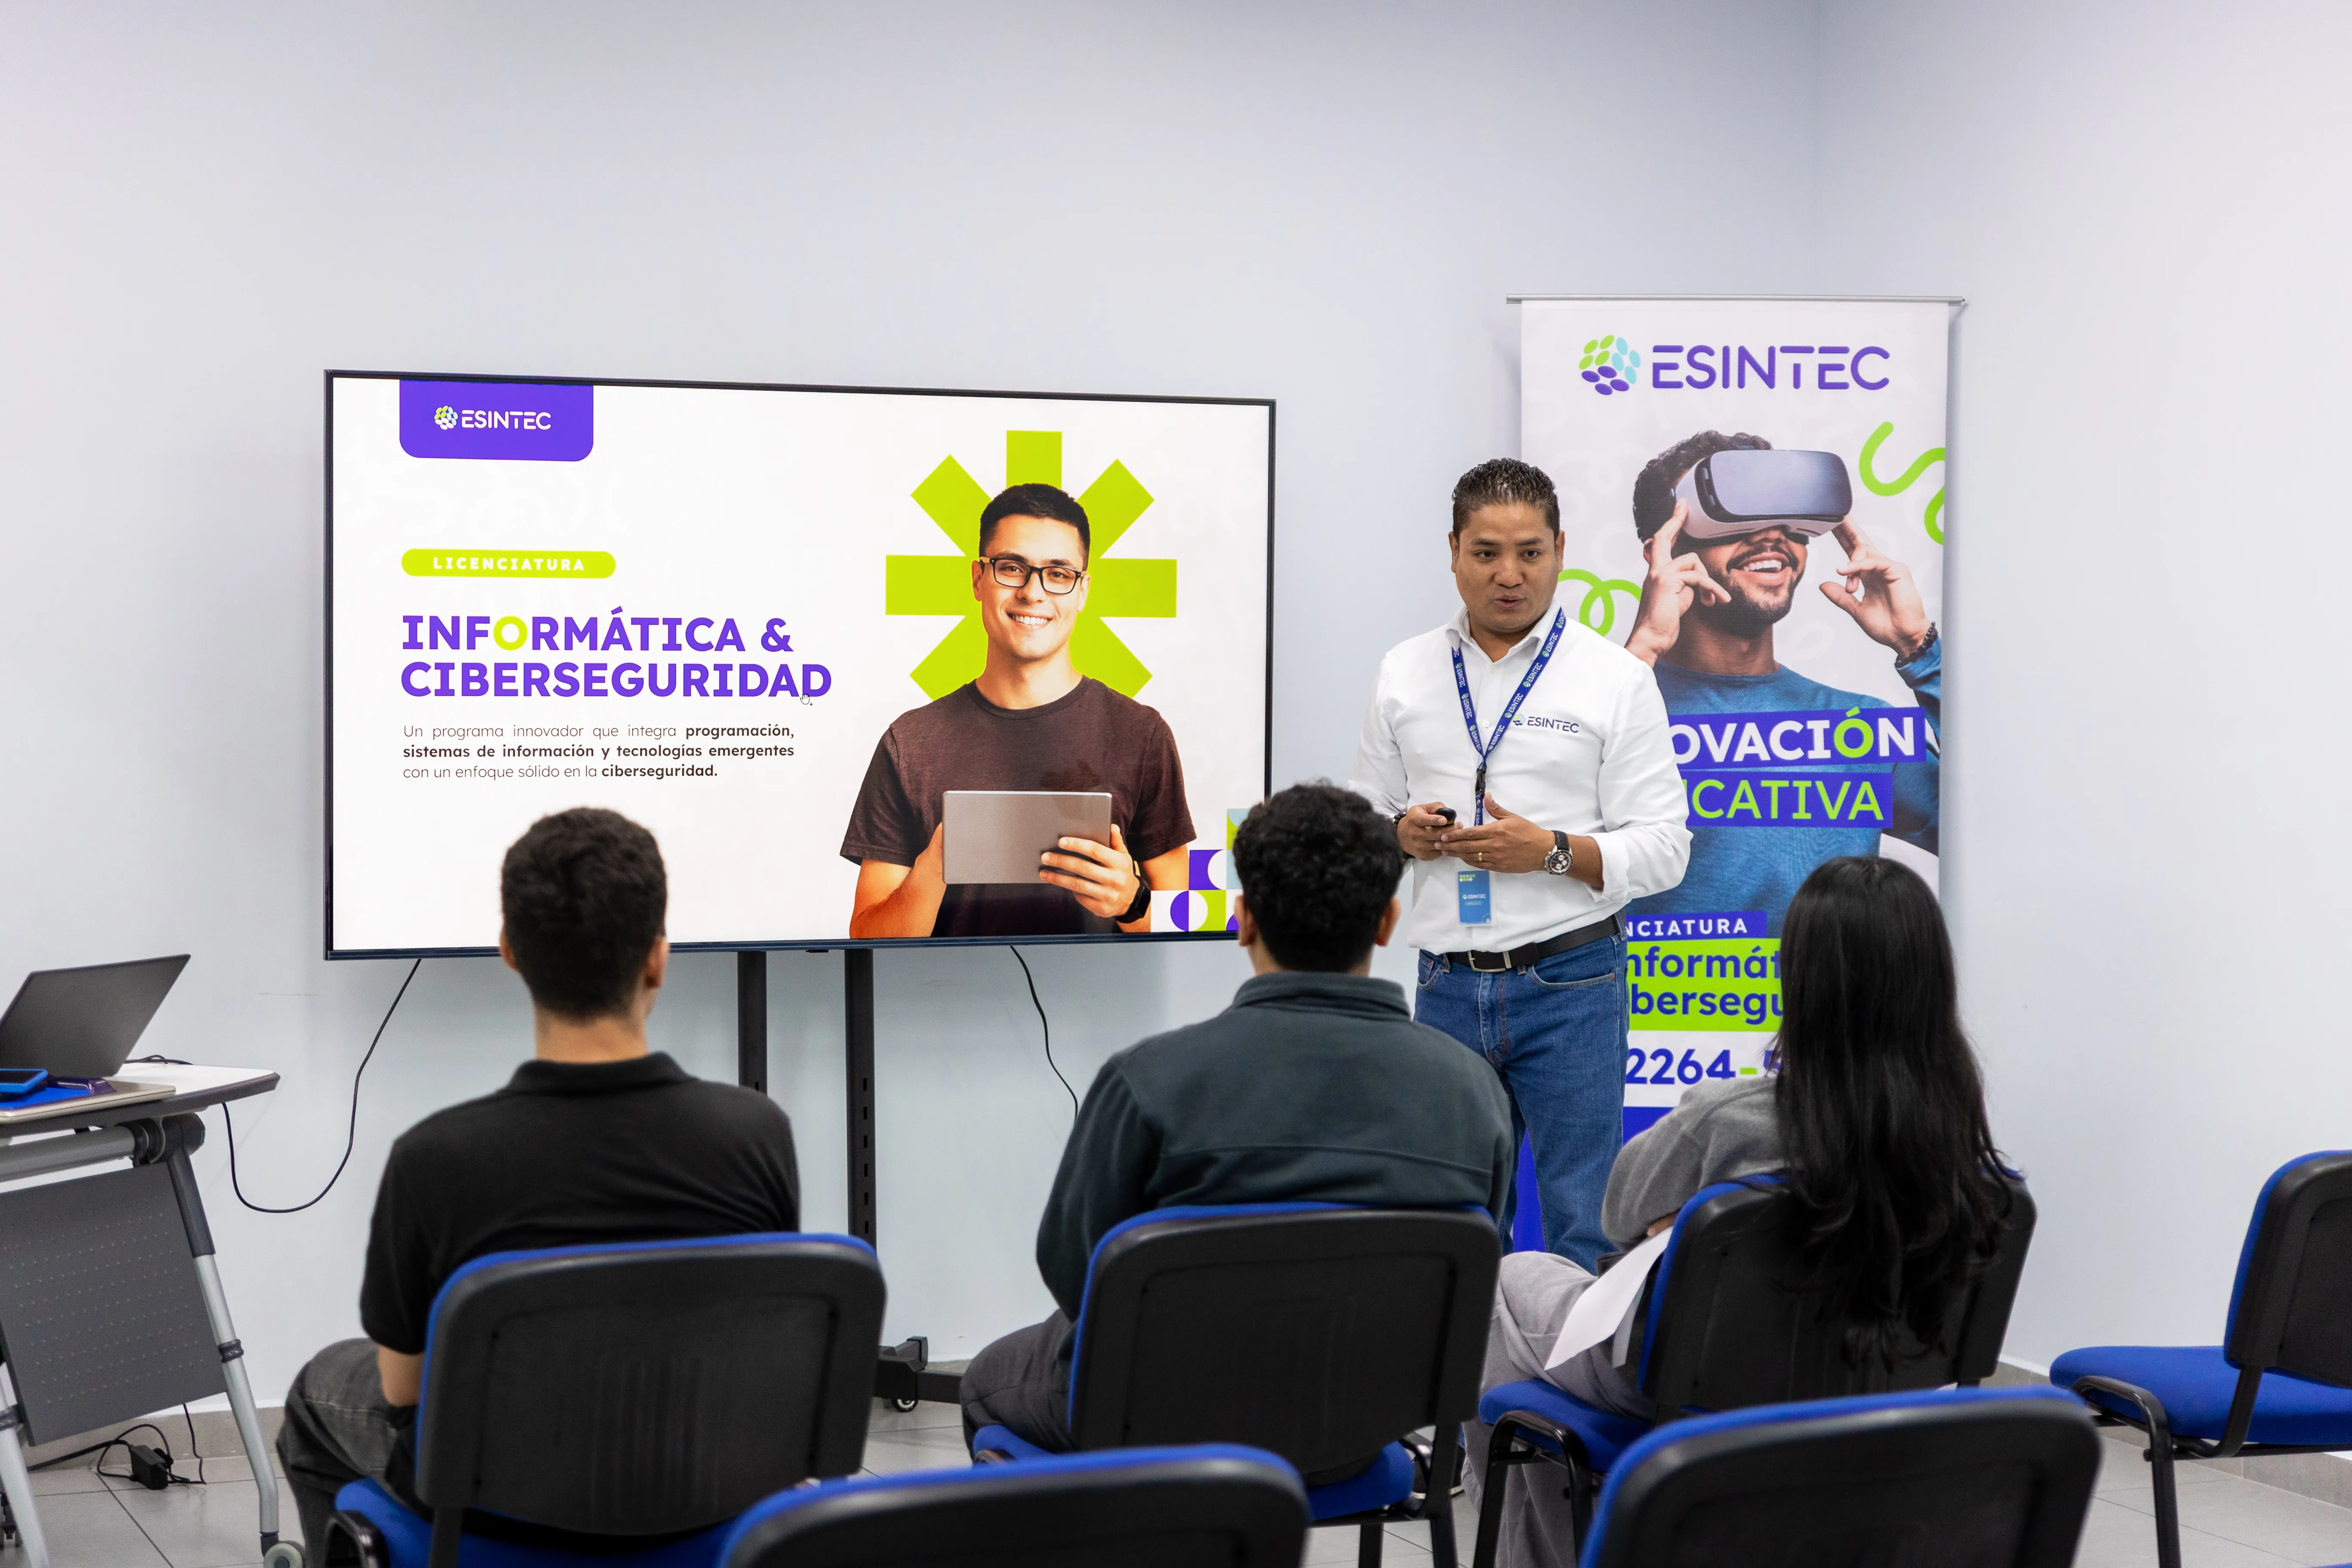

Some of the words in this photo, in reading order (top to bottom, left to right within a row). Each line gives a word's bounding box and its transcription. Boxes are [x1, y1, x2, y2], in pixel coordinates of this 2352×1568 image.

[1652, 345, 1890, 391] ESINTEC
[462, 410, 551, 430] ESINTEC
[434, 557, 584, 571] LICENCIATURA
[403, 606, 746, 652] INFORMÁTICA
[761, 618, 794, 652] &
[1546, 633, 1558, 652] ESINTEC
[401, 662, 832, 698] CIBERSEGURIDAD
[1457, 668, 1465, 687] ESINTEC
[1527, 662, 1542, 683] ESINTEC
[1463, 698, 1472, 719] ESINTEC
[1508, 693, 1523, 713] ESINTEC
[404, 725, 423, 737] Un
[433, 728, 503, 741] programa
[514, 725, 584, 737] innovador
[593, 728, 619, 740] que
[628, 724, 676, 740] integra
[686, 723, 794, 740] programación,
[1491, 725, 1504, 745] ESINTEC
[1527, 717, 1579, 733] ESINTEC
[1471, 730, 1482, 751] ESINTEC
[1669, 707, 1915, 764] OVACIÓN
[403, 744, 470, 757] sistemas
[477, 745, 495, 757] de
[503, 744, 594, 757] información
[601, 748, 610, 760] y
[616, 744, 702, 760] tecnologías
[709, 745, 794, 760] emergentes
[403, 769, 429, 778] con
[434, 769, 450, 778] un
[456, 766, 514, 781] enfoque
[518, 765, 560, 778] sólido
[564, 768, 580, 777] en
[585, 765, 597, 777] la
[601, 763, 717, 780] ciberseguridad.
[1682, 779, 1884, 821] CATIVA
